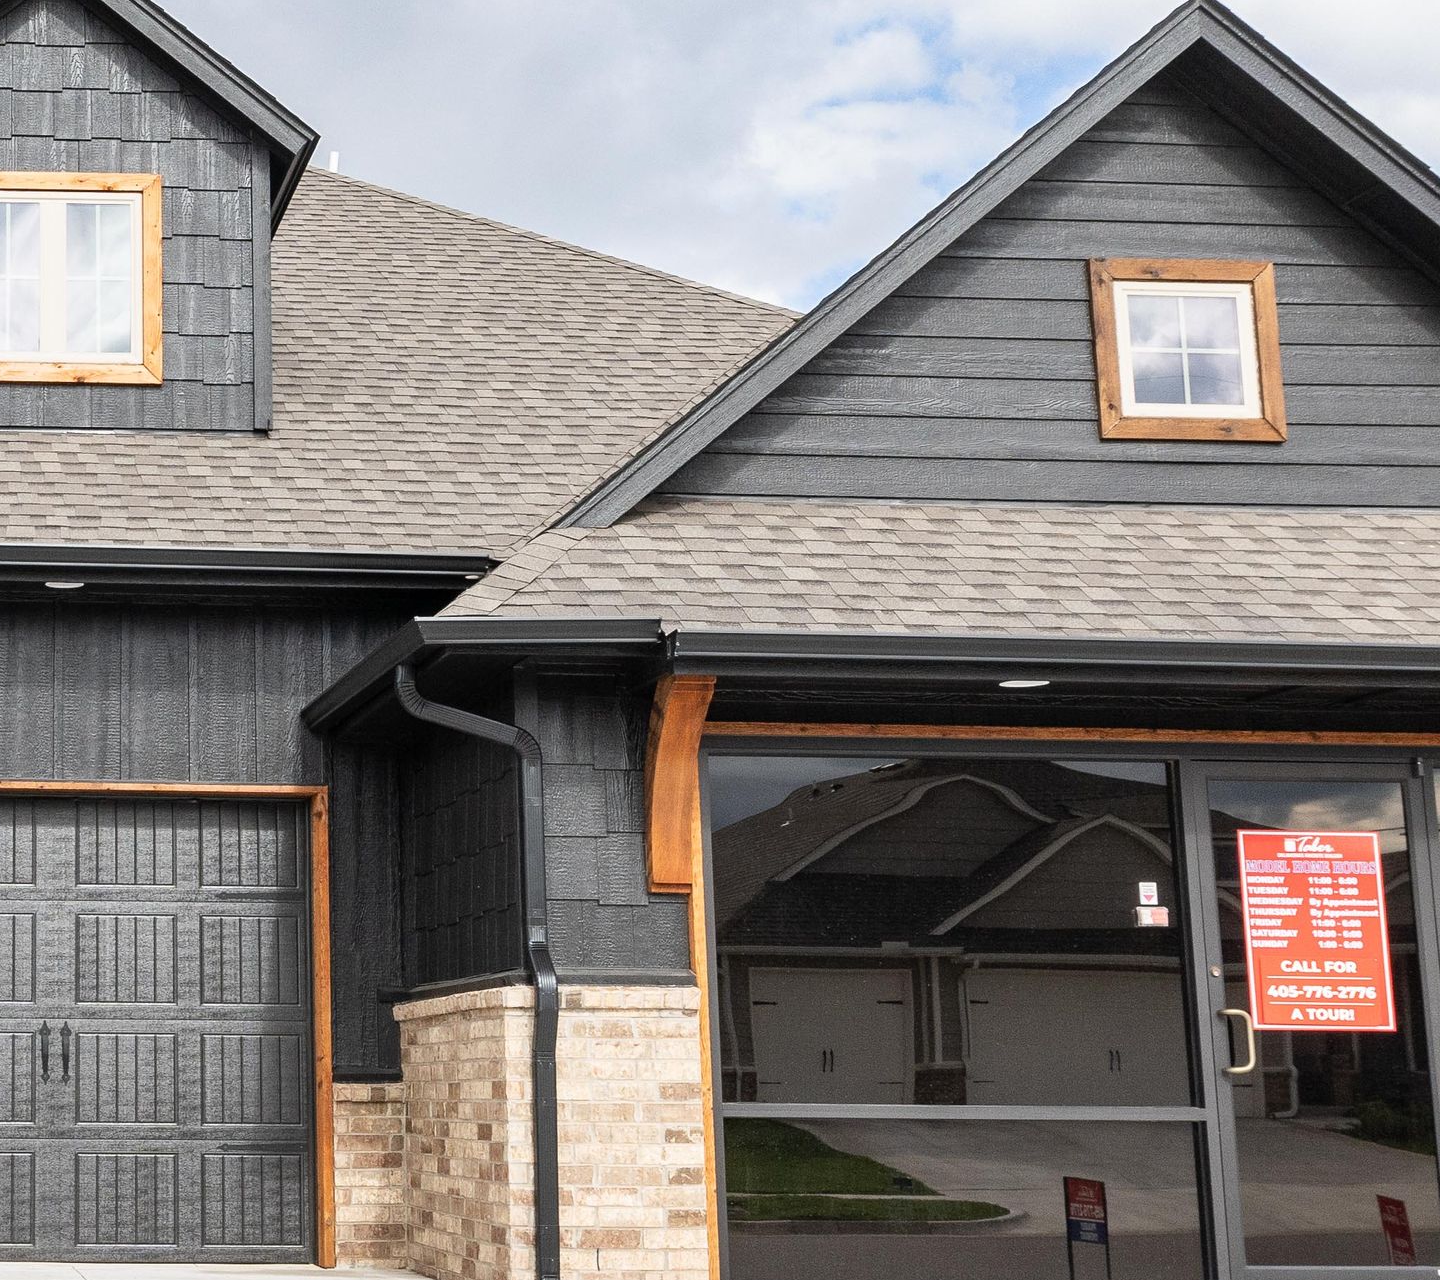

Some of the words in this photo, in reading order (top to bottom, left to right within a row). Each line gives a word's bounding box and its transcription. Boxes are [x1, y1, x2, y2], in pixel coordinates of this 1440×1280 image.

[1280, 960, 1321, 973] CALL
[1324, 961, 1357, 974] FOR
[1267, 984, 1377, 1000] 405-776-2776
[1291, 1007, 1304, 1021] A
[1306, 1008, 1356, 1021] TOUR!
